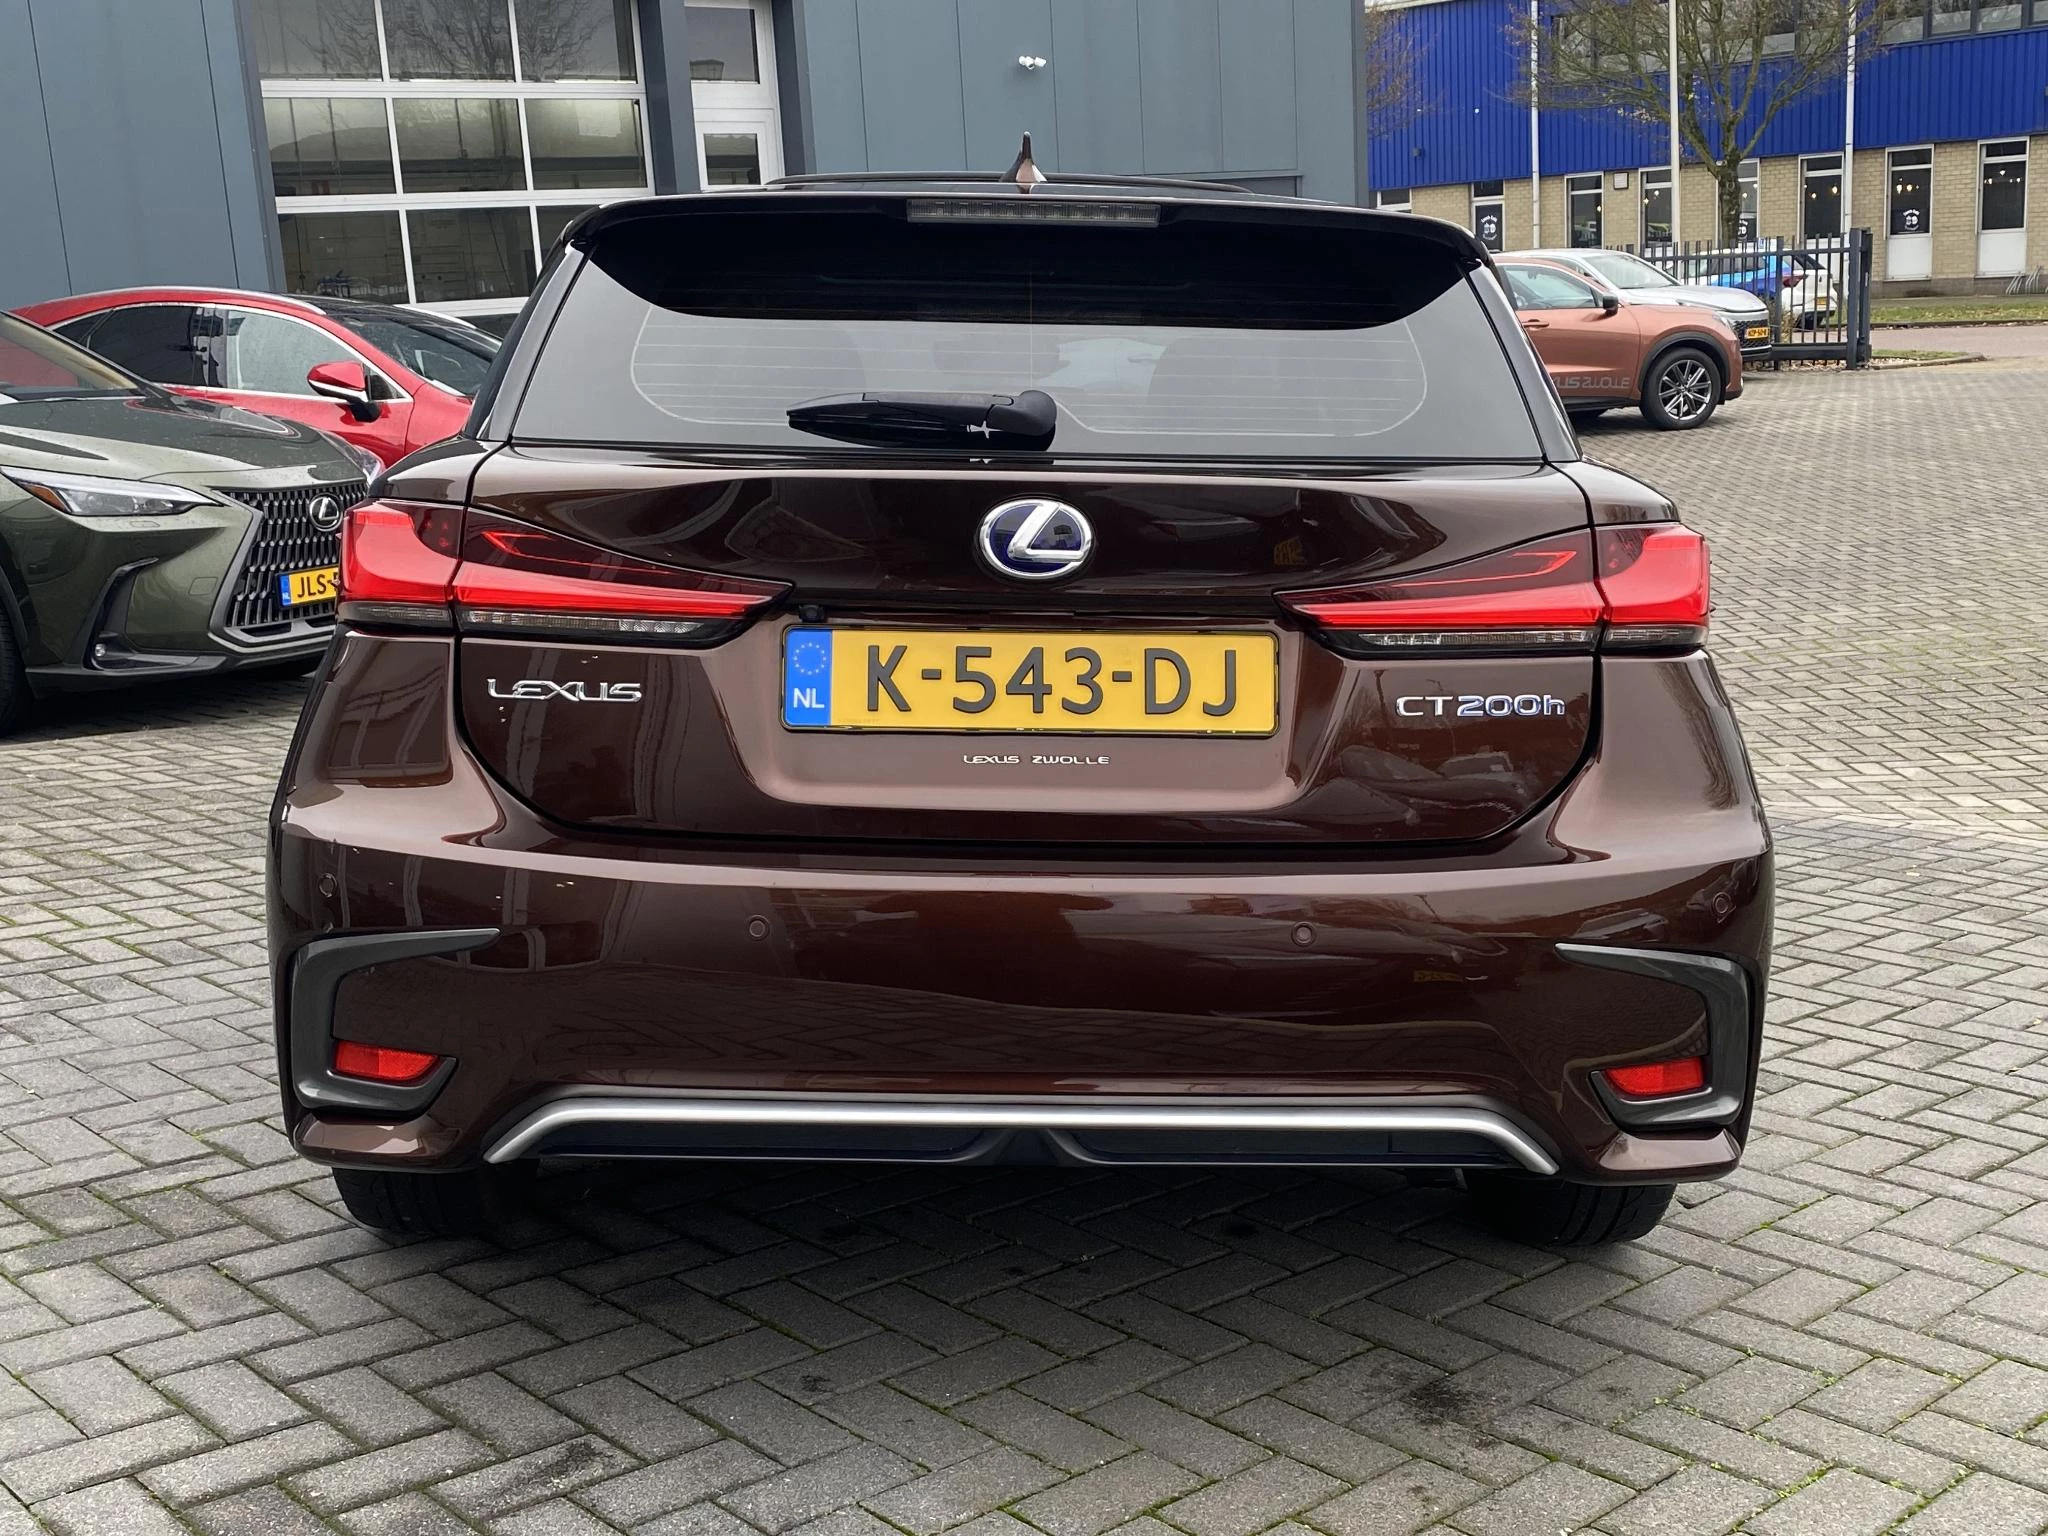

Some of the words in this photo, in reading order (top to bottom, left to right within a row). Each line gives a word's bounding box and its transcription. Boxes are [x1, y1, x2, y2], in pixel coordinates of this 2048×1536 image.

[487, 678, 643, 703] LEXUS
[866, 644, 1238, 717] K-543-DJ
[793, 687, 825, 709] NL
[963, 755, 1020, 764] LEXUS
[1031, 755, 1110, 765] ZWOLLE
